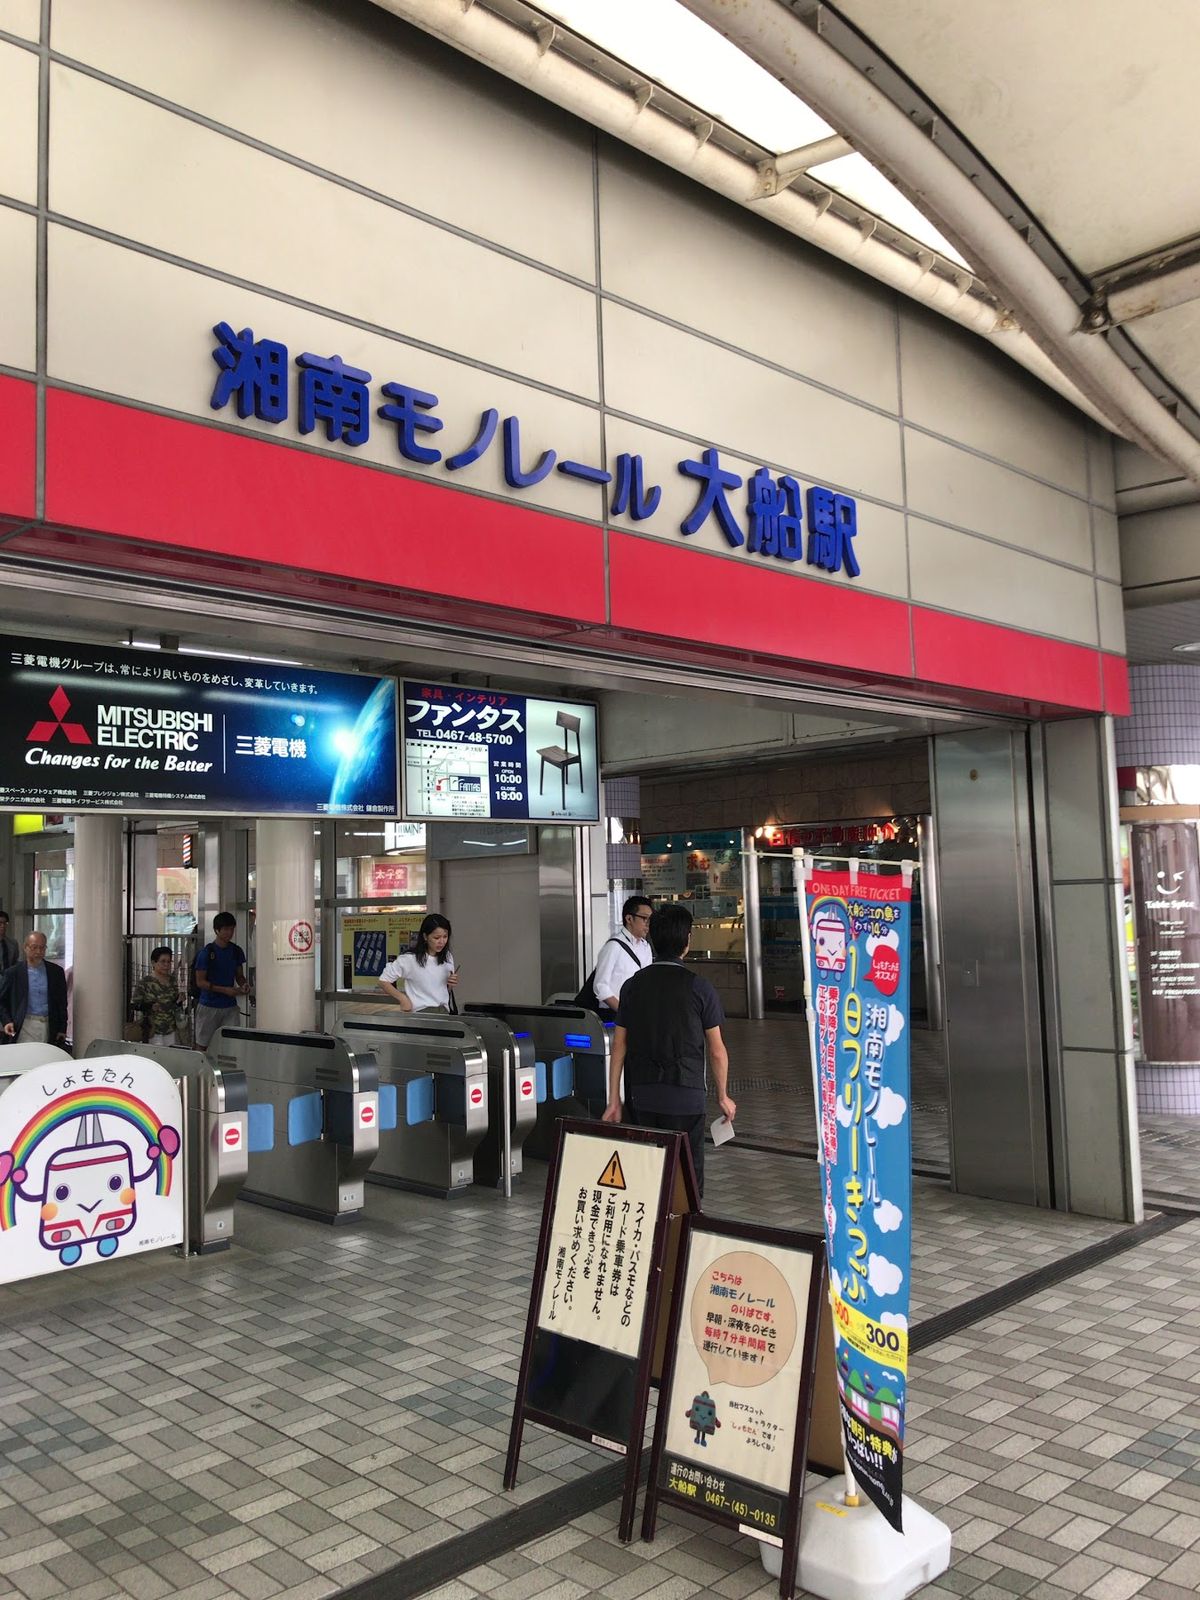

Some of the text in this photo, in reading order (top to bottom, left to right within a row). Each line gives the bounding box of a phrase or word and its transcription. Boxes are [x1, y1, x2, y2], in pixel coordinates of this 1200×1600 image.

[10, 652, 319, 695] 三菱電機グループは、常により良いものをめざし、変革していきます。
[97, 704, 213, 732] MITSUBISHI
[406, 699, 524, 733] ファンタス
[97, 726, 200, 751] ELECTRIC
[235, 734, 307, 759] 三菱電機
[25, 746, 213, 773] Changes for the Better
[494, 773, 522, 784] 10:00
[495, 791, 523, 801] 19:00
[867, 887, 901, 900] TICKET
[42, 1067, 135, 1097] しょもたん
[864, 1003, 888, 1204] 湘南モノレール
[583, 1189, 602, 1279] 現金できっぷを
[609, 1200, 631, 1296] カード乗車券は
[563, 1187, 588, 1311] お買い求めください。
[592, 1192, 618, 1320] ご利用になれません。
[620, 1201, 645, 1327] スイカ・パスモなどの
[711, 1270, 743, 1286] こちらは
[548, 1246, 567, 1320] 湘南モノレール
[710, 1283, 776, 1308] 湘南モノレール
[706, 1311, 777, 1339] 早朝・深夜をのぞき
[730, 1303, 775, 1324] のりばです。
[866, 1322, 900, 1352] 300
[668, 1478, 698, 1498] 大船駅
[670, 1462, 726, 1493] 運行のお問い合わせ
